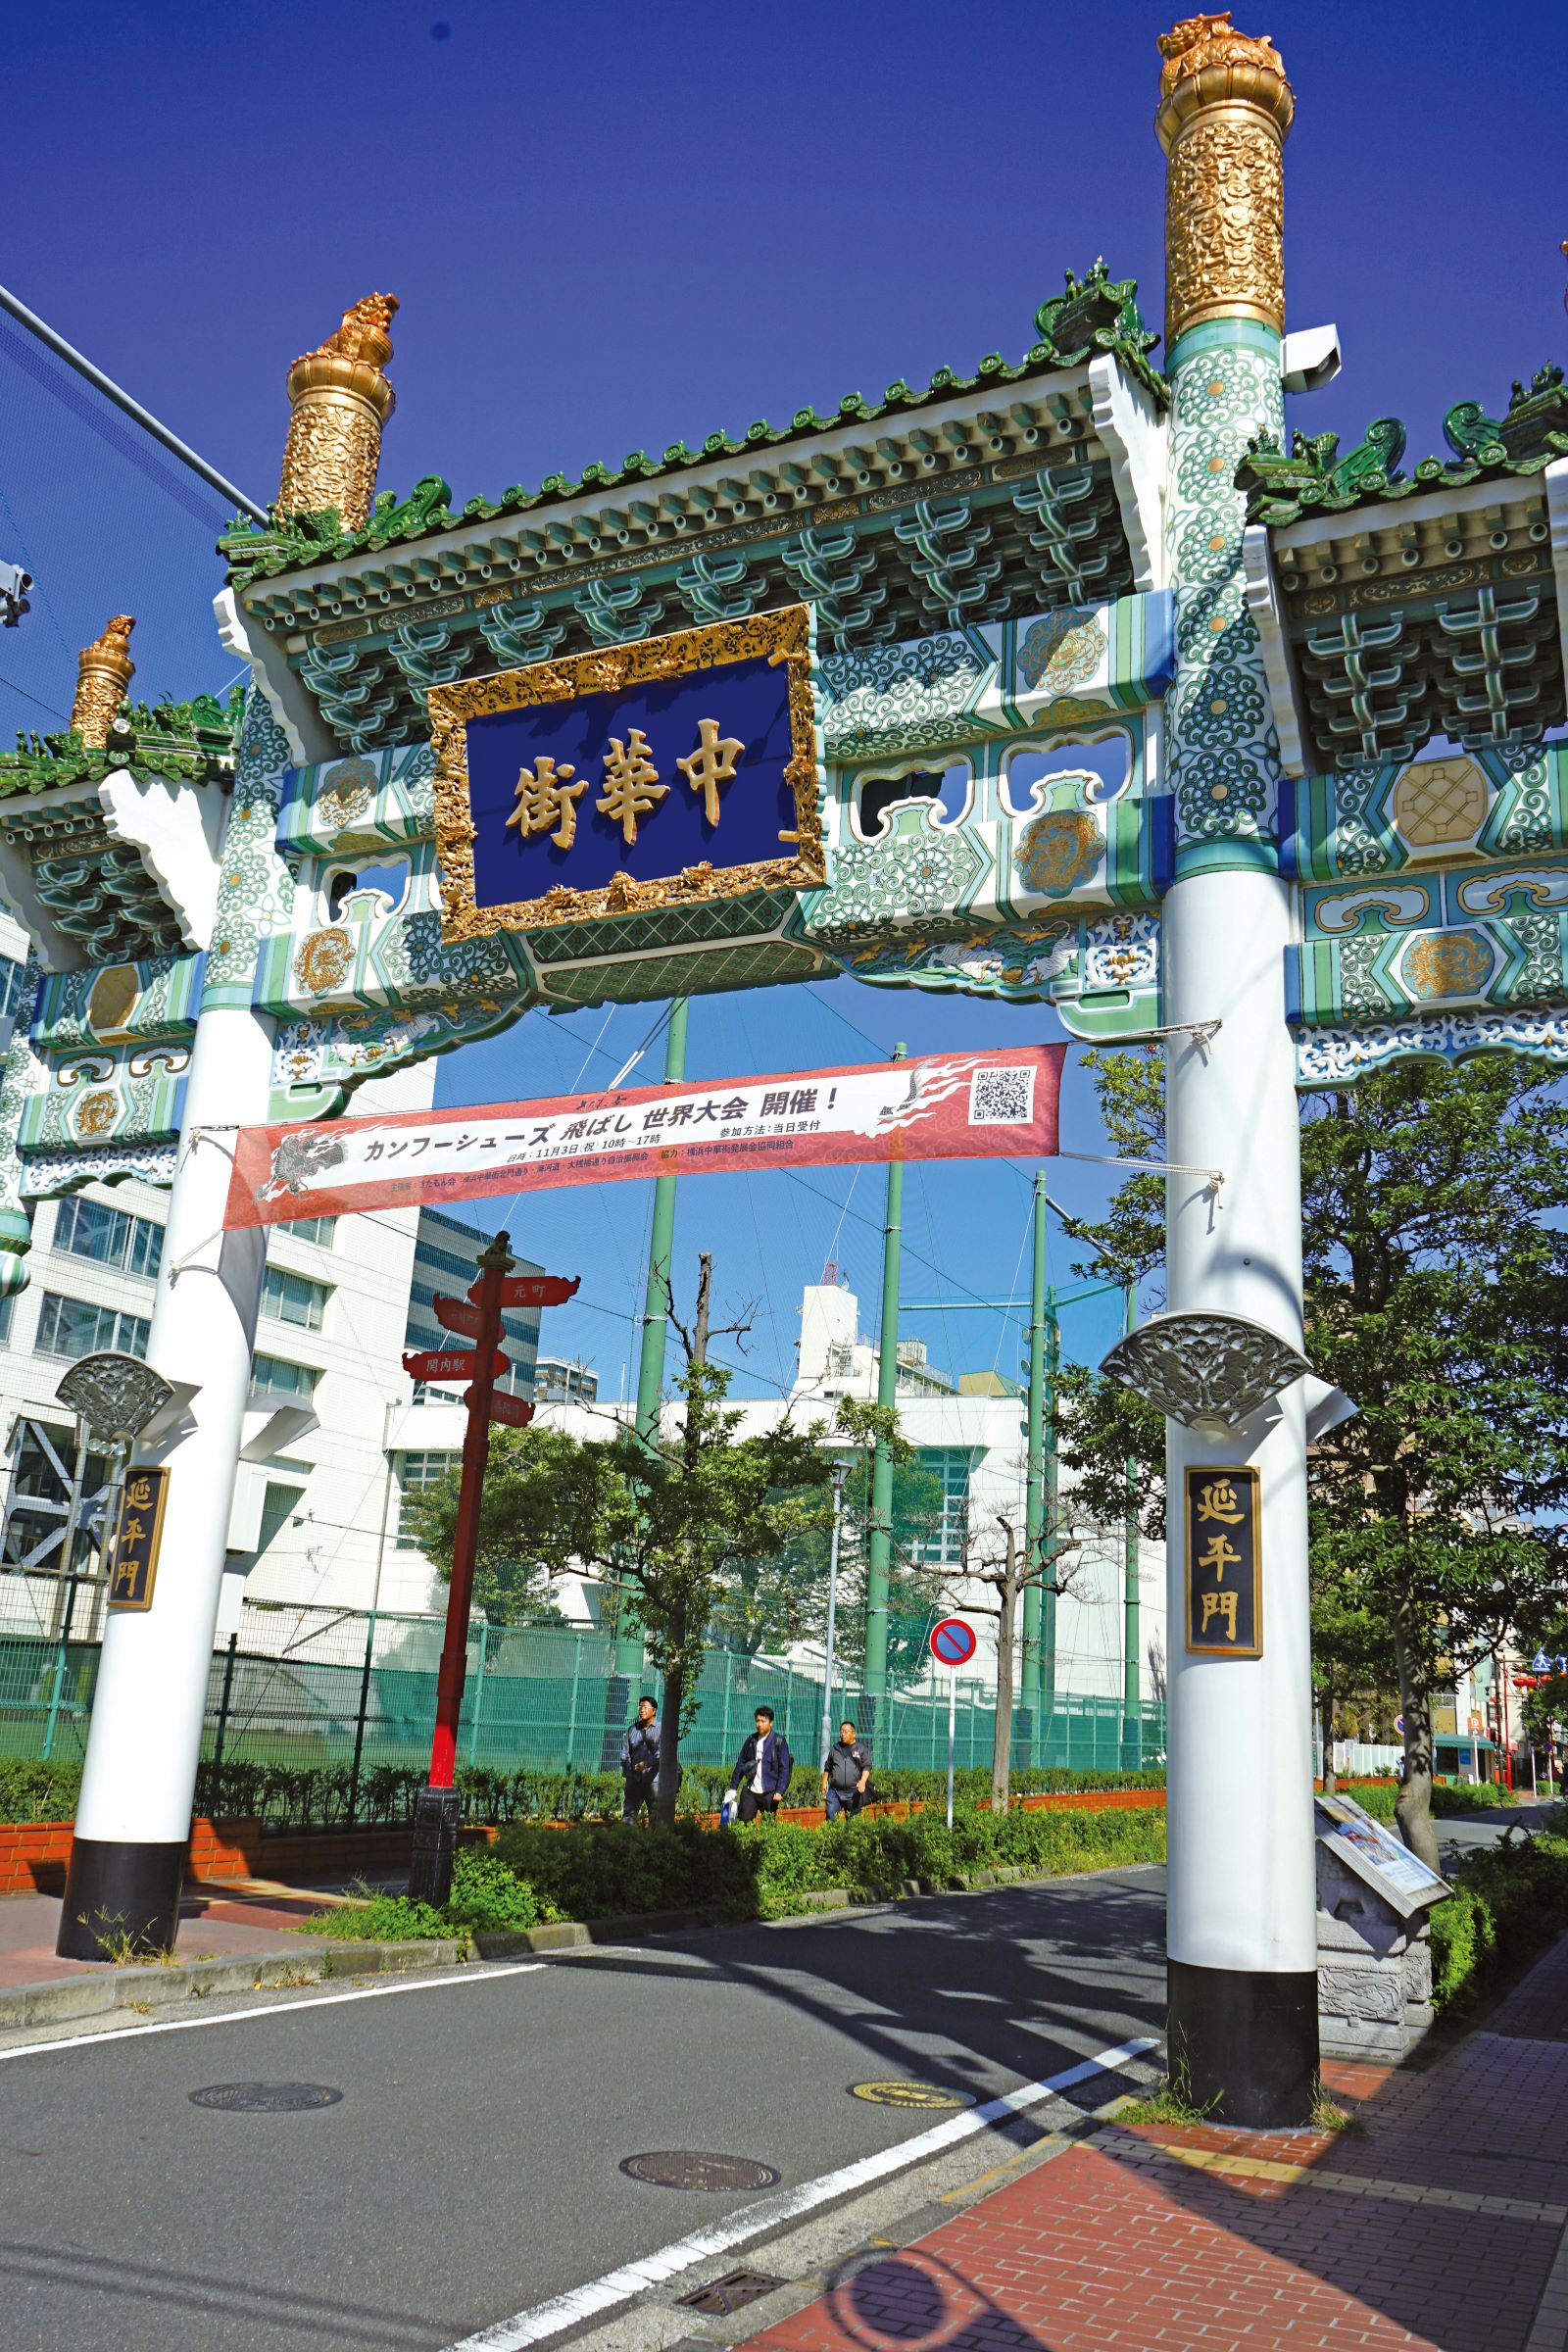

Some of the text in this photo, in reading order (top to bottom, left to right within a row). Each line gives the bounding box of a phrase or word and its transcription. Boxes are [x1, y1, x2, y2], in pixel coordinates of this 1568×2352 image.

[506, 718, 746, 851] 中華街
[364, 1122, 557, 1162] カンフーシューズ
[561, 1111, 634, 1141] 飛ばし
[643, 1096, 750, 1129] 世界大会
[760, 1087, 838, 1118] 開催！
[719, 1119, 821, 1139] 参加方法：当日受付
[513, 1285, 547, 1298] 元町
[426, 1357, 467, 1373] 関内駅
[114, 1476, 155, 1598] 延平門
[1196, 1478, 1247, 1642] 延平門
